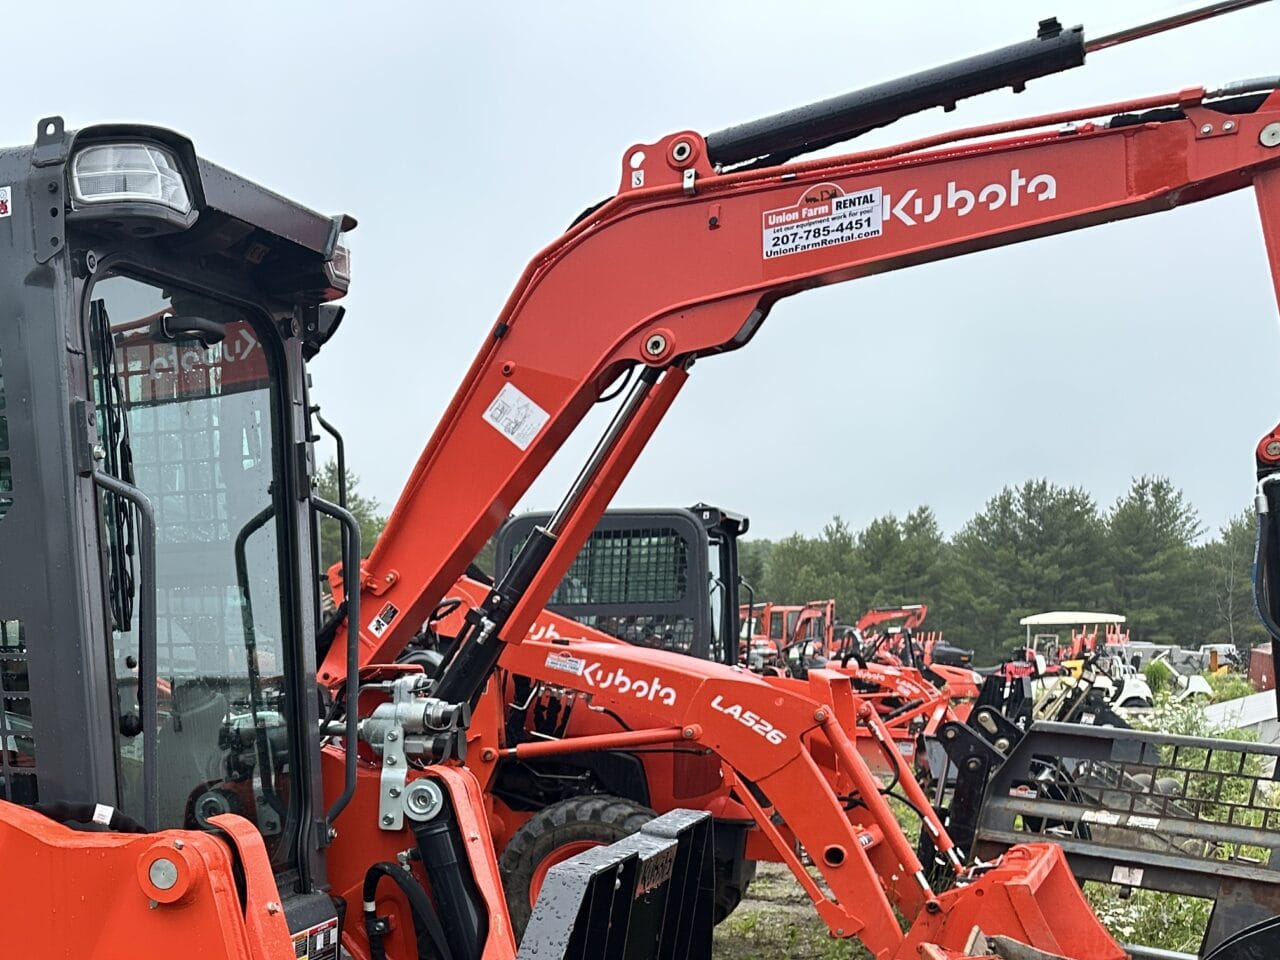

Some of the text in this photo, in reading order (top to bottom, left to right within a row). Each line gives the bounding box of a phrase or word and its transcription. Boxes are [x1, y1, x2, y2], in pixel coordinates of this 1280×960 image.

[768, 194, 875, 225] Union Farm RENTAL
[883, 168, 1057, 227] Kubota
[772, 216, 872, 247] 207-785-4451
[795, 217, 830, 229] equipment
[831, 213, 847, 221] work
[848, 210, 858, 218] for
[765, 229, 880, 258] UnionFarmRental.com
[577, 658, 677, 706] Kubota
[710, 694, 788, 745] LA526
